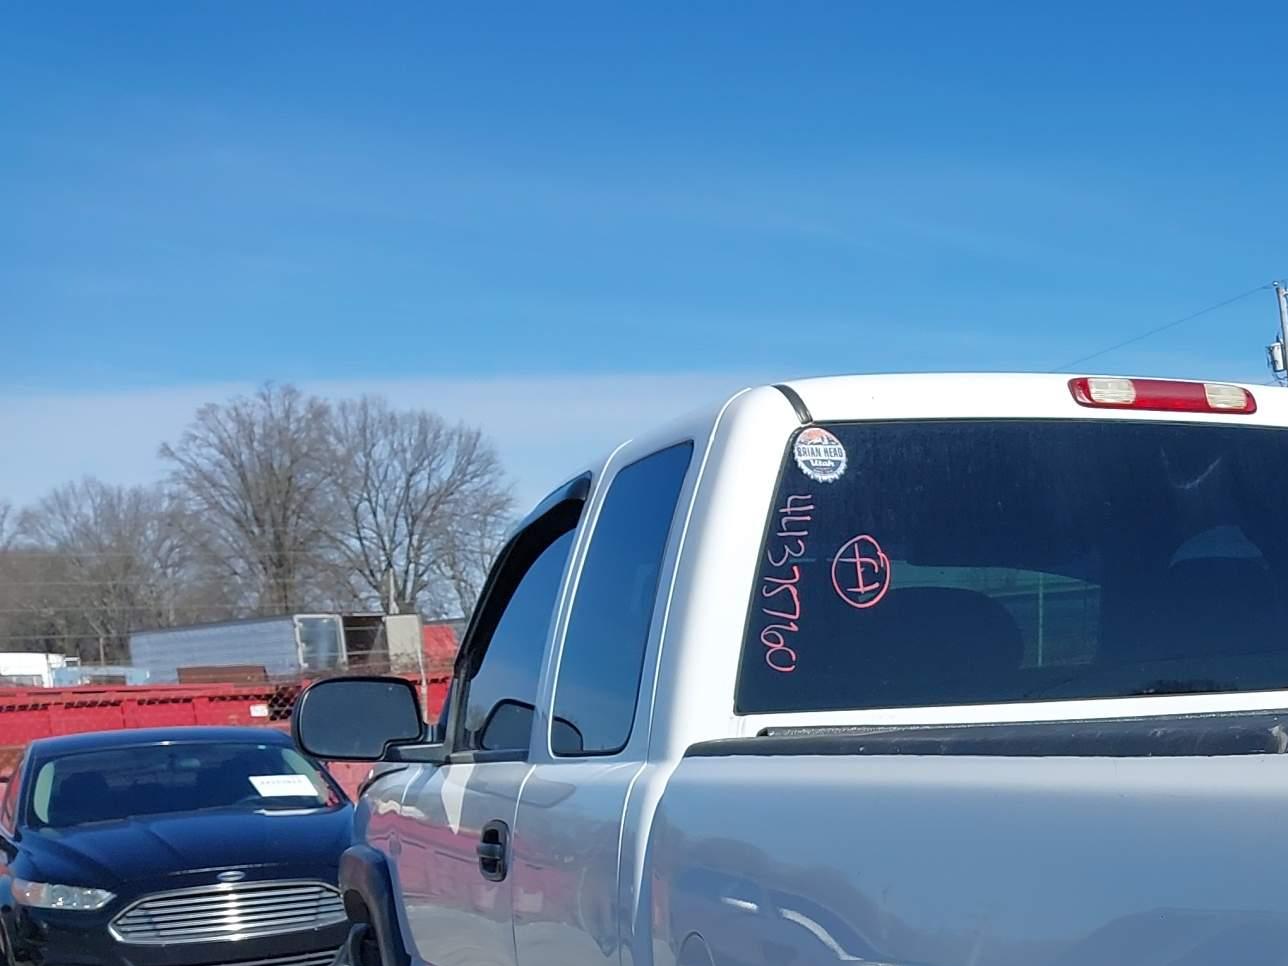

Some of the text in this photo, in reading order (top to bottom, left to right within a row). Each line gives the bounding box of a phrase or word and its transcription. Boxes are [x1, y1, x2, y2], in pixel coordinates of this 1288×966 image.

[797, 446, 844, 458] BRIAN HEAD
[760, 494, 817, 673] 44375760
